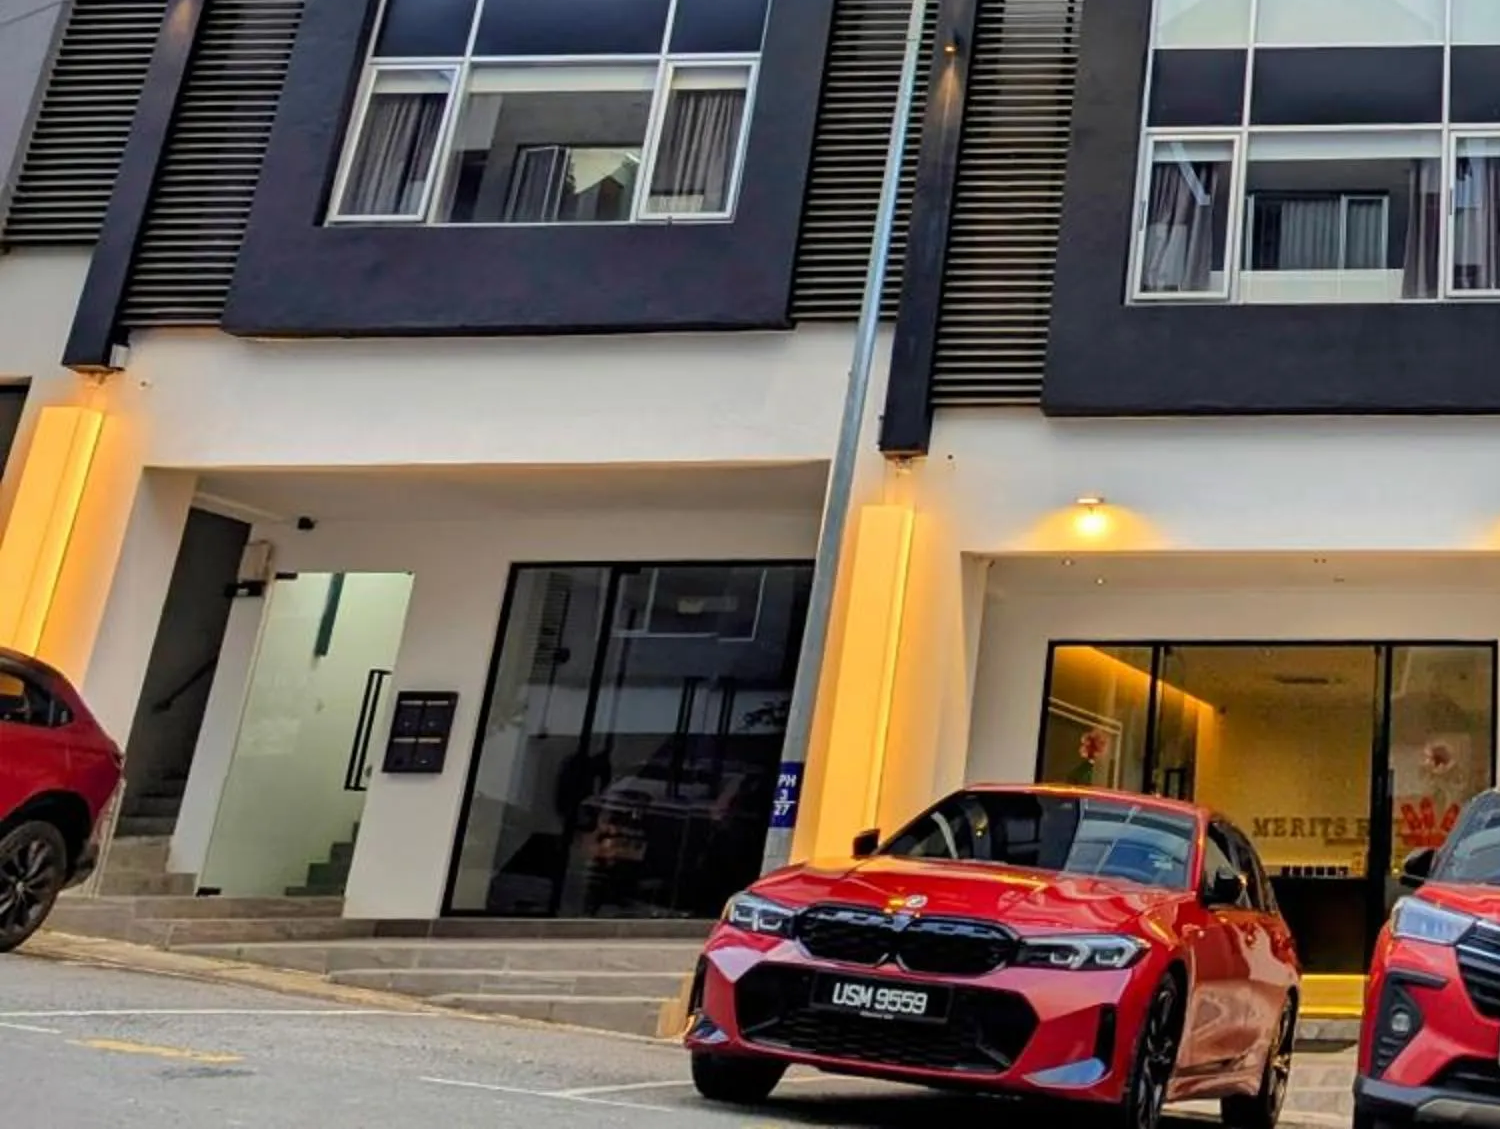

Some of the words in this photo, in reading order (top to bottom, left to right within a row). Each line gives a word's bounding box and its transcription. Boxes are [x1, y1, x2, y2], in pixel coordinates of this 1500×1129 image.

[1252, 817, 1344, 839] MERITS
[832, 982, 873, 1009] USM
[874, 988, 928, 1014] 9559
